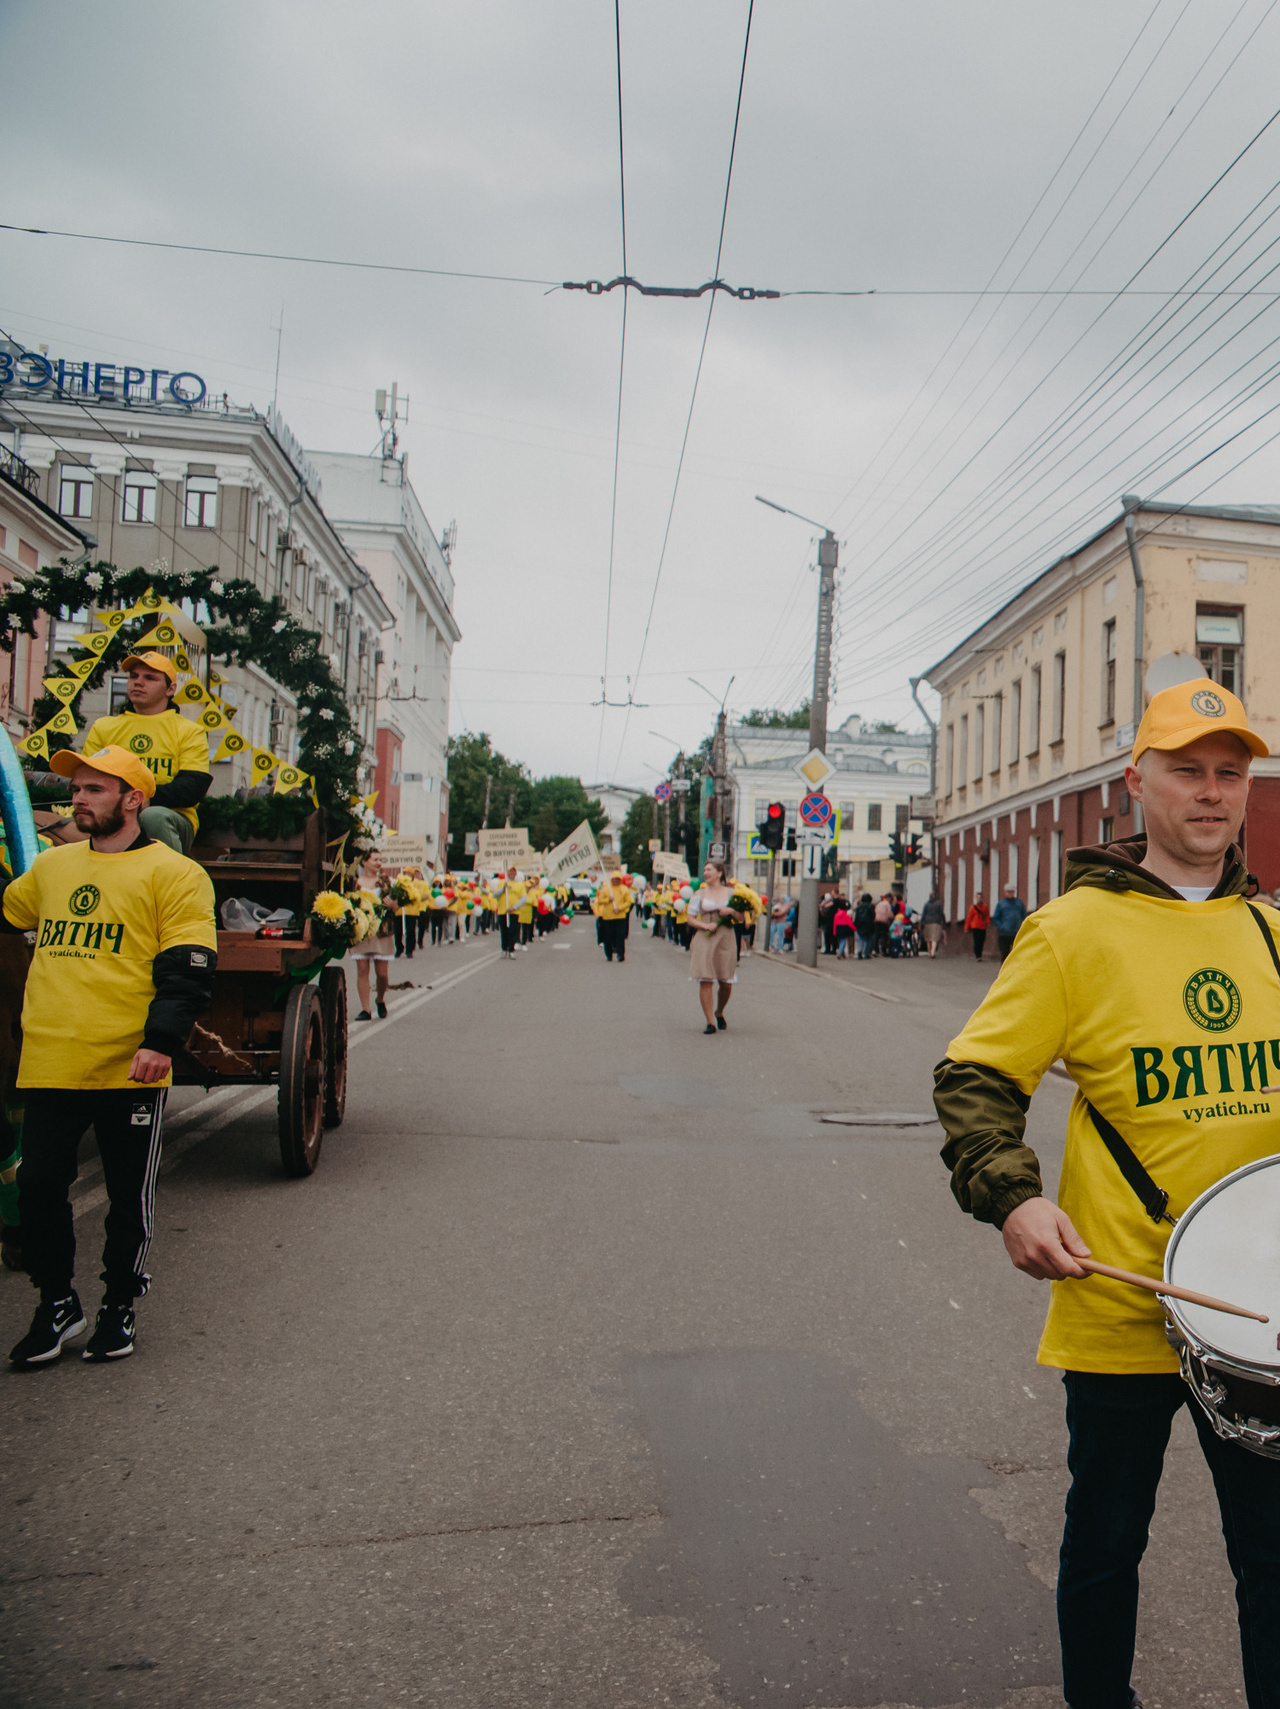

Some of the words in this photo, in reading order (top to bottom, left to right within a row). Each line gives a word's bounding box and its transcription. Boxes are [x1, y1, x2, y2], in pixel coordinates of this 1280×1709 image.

[38, 919, 125, 954] ВЯТИЧ
[49, 949, 96, 960] vyatich.ru
[1190, 972, 1231, 989] ВЯТИЧ
[1182, 1101, 1271, 1123] vyatich.ru
